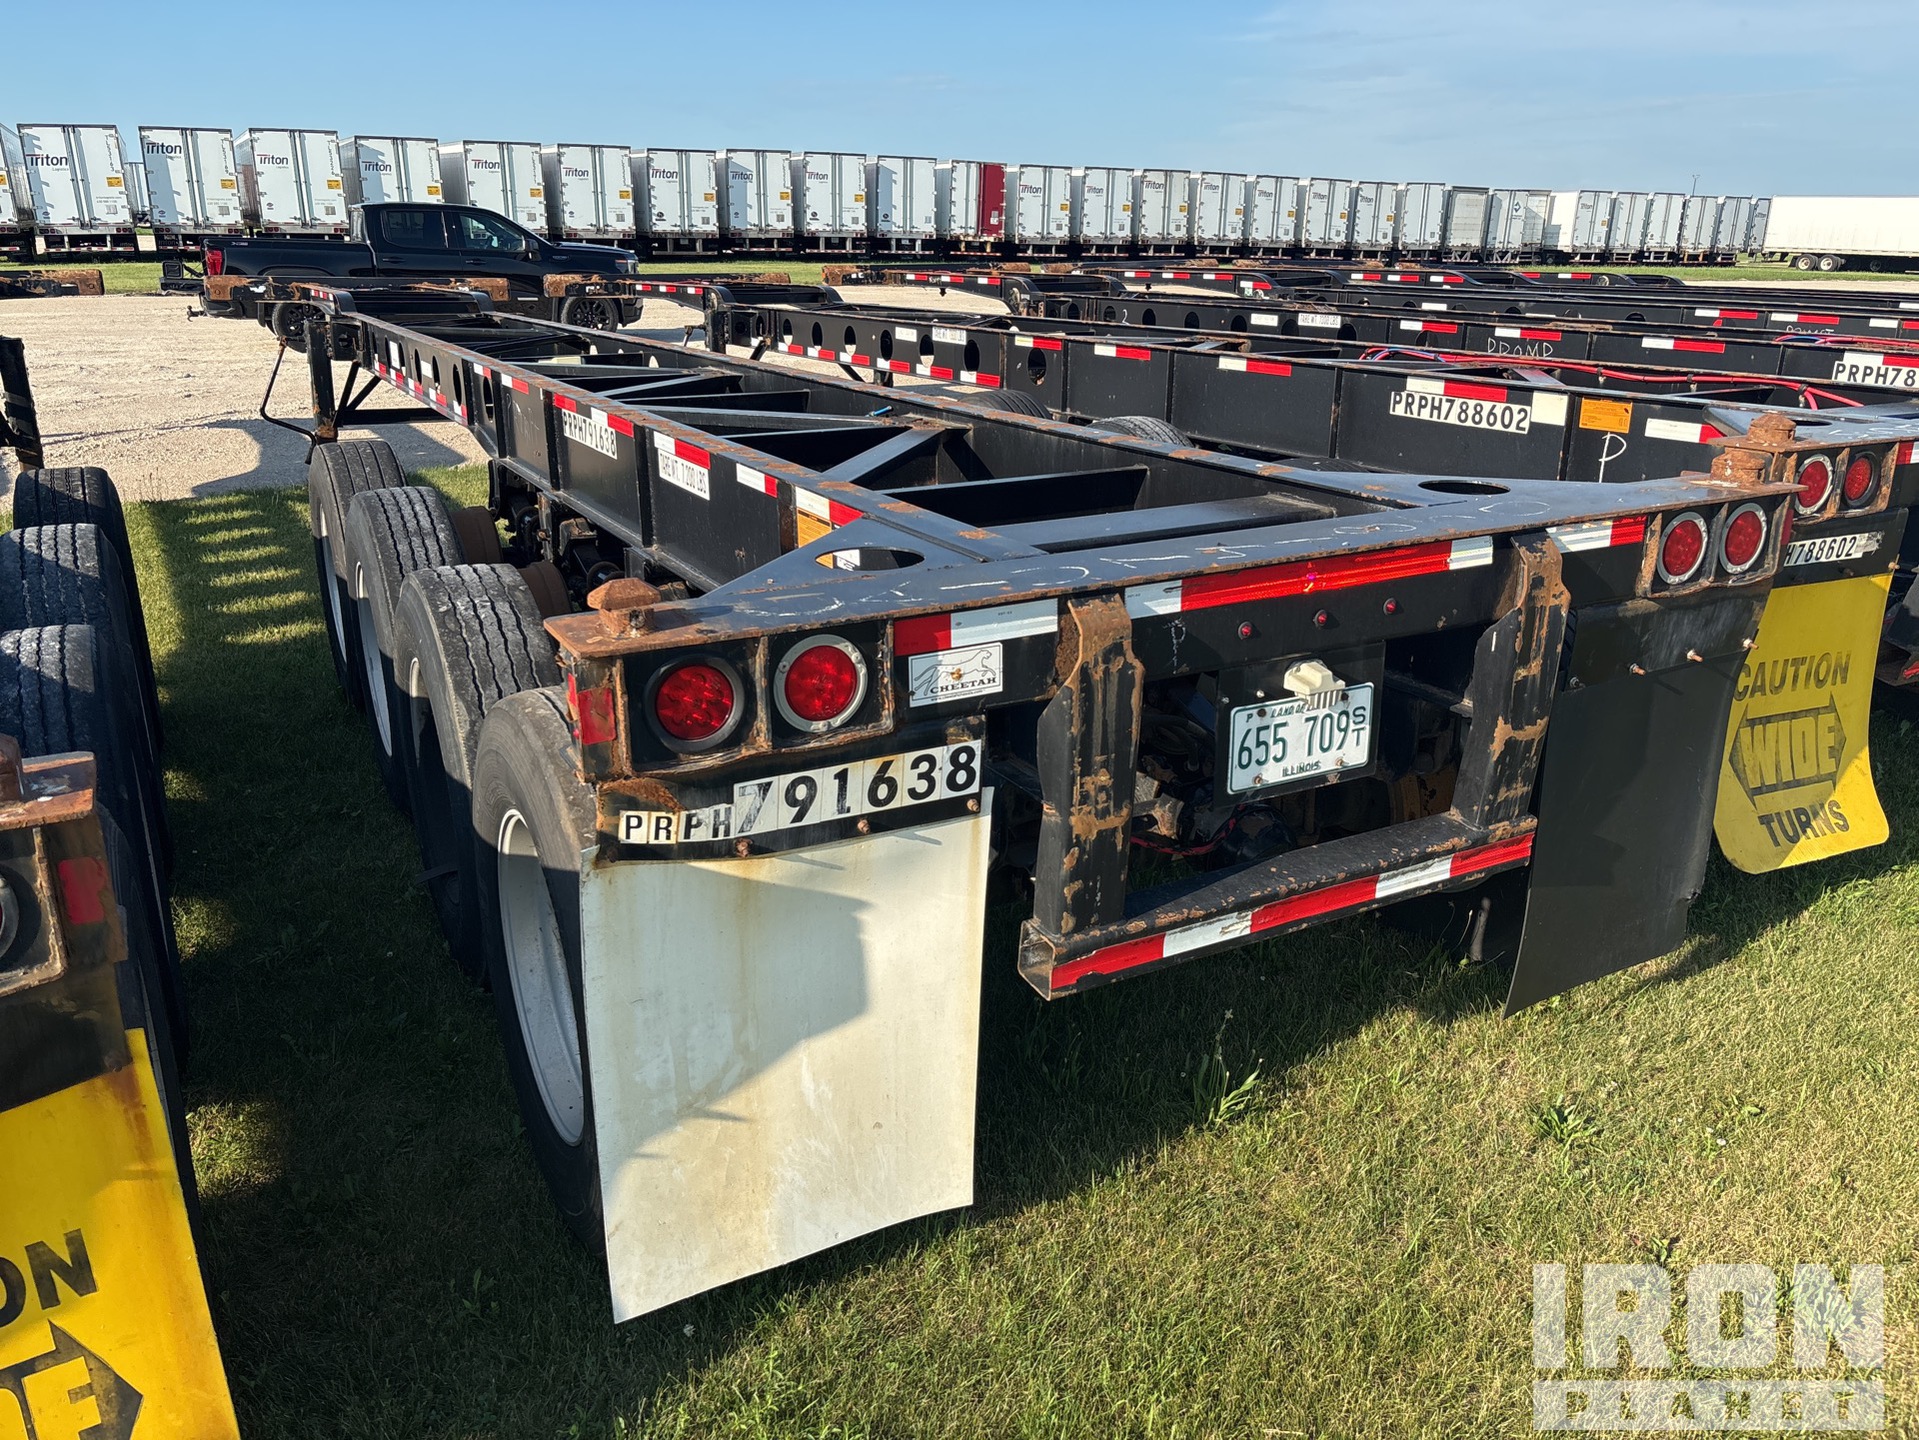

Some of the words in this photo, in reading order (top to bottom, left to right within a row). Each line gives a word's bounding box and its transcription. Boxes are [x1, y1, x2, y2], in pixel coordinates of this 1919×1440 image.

[145, 142, 182, 155] Triton
[26, 153, 69, 168] Triton
[257, 154, 289, 165] Triton
[471, 159, 501, 170] Triton
[361, 161, 392, 172] Triton
[563, 167, 589, 178] Triton
[651, 168, 678, 179] Triton
[730, 170, 754, 181] Triton
[807, 171, 828, 180] Triton
[1020, 184, 1042, 194] Triton
[1086, 186, 1104, 195] Triton
[1145, 180, 1164, 190] Triton
[1204, 182, 1220, 191] Triton
[1834, 363, 1917, 387] PRPH78
[1392, 392, 1529, 432] PRPH788602
[562, 411, 616, 457] PRPH791638
[1598, 432, 1627, 484] P
[1733, 651, 1852, 702] CAUTION
[930, 677, 997, 695] CHEETAH
[1238, 721, 1288, 770] 655
[1305, 710, 1350, 756] 709
[1738, 713, 1836, 789] WIDE
[1282, 759, 1322, 777] ILLINOIS
[1757, 799, 1850, 848] TURNS
